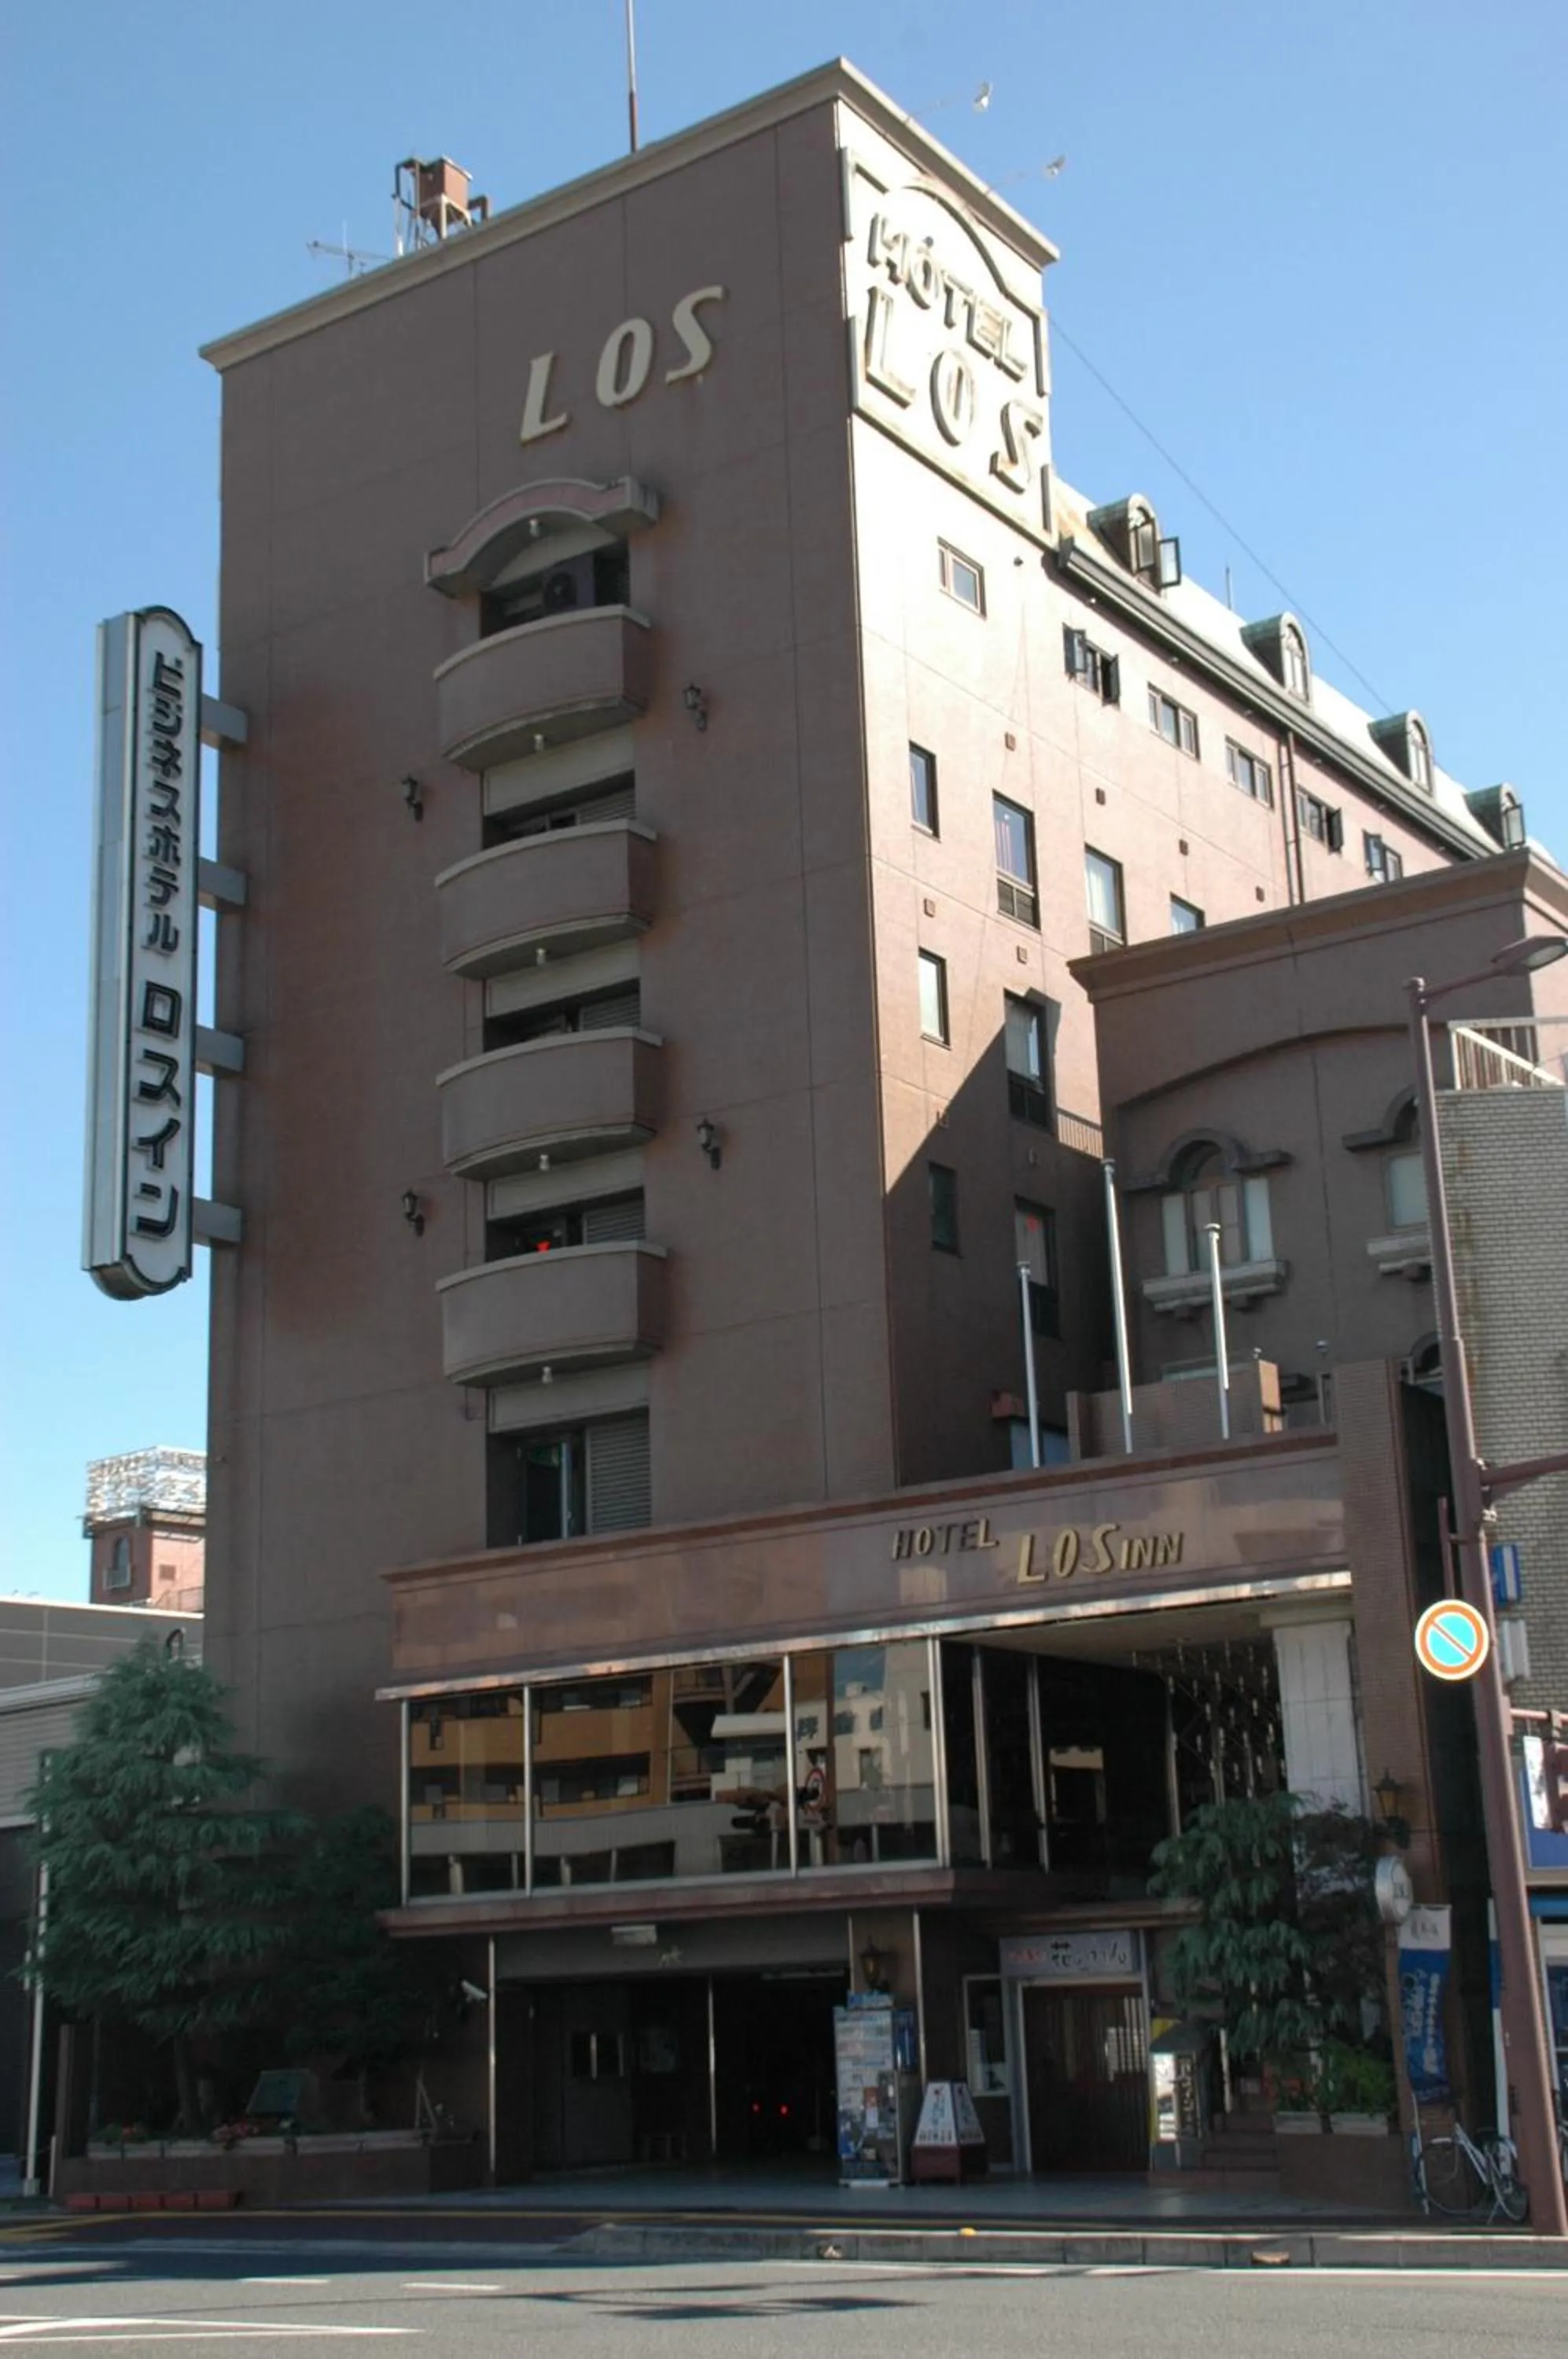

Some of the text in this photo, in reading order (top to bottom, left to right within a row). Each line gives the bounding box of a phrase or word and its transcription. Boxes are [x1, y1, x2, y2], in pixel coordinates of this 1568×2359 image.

[520, 285, 725, 444] LOS
[867, 212, 1027, 383] HOTEL
[864, 285, 1044, 496] LOS
[134, 650, 186, 1240] ビジネスホテル ロスイン
[892, 1518, 999, 1560] HOTEL
